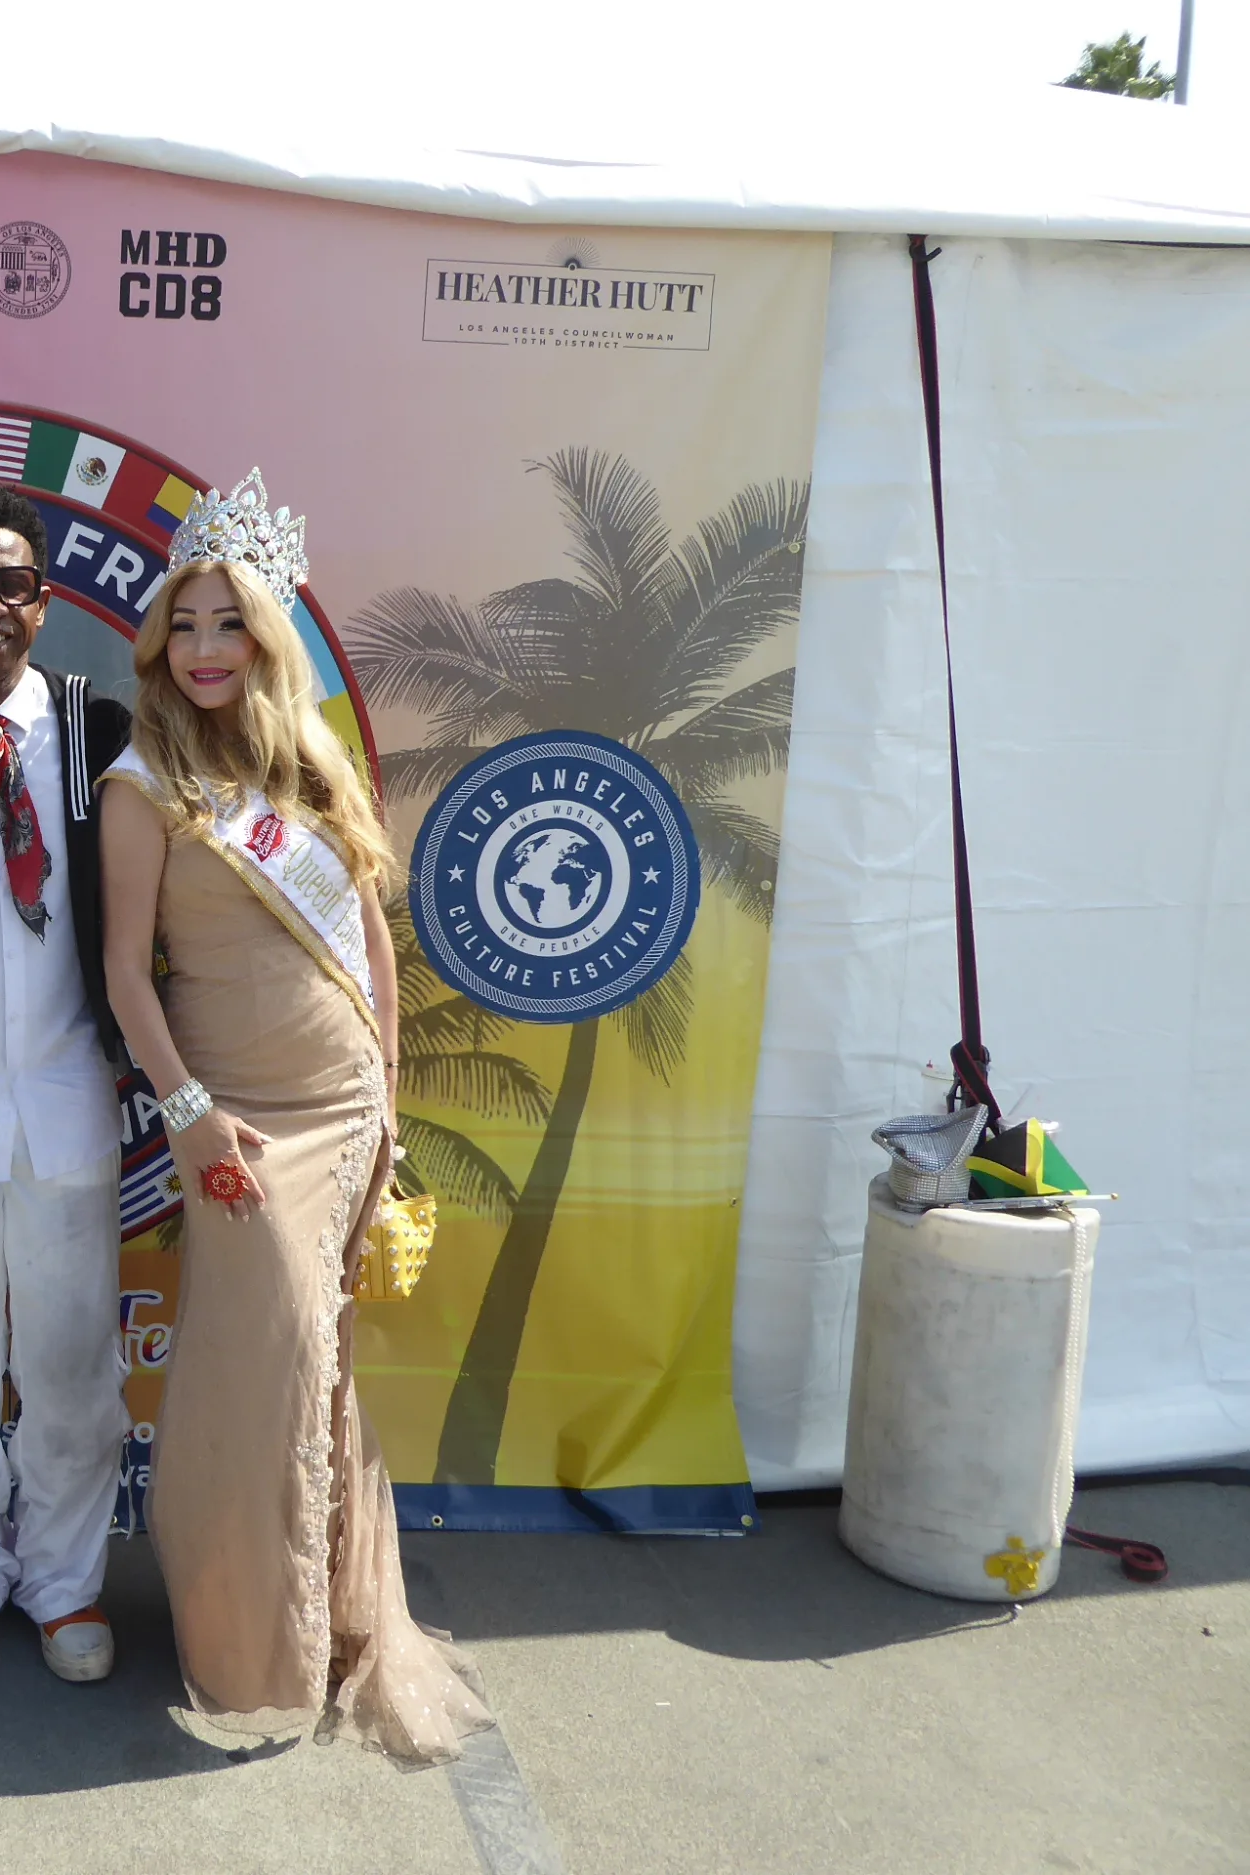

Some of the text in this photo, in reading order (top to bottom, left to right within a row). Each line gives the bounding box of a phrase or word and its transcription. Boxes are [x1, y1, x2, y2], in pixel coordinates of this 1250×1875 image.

[120, 229, 227, 269] MHD
[119, 272, 223, 321] CD8
[436, 271, 703, 313] HEATHER HUTT
[459, 324, 675, 341] LOS ANGELES COUNCILWOMAN
[555, 339, 619, 349] DISTRICT
[458, 768, 654, 848] LOS ANGELES
[510, 804, 604, 831] ONE WORLD
[282, 839, 343, 920] Queen
[449, 904, 657, 988] CULTURE FESTIVAL
[500, 925, 600, 952] ONE PEOPLE
